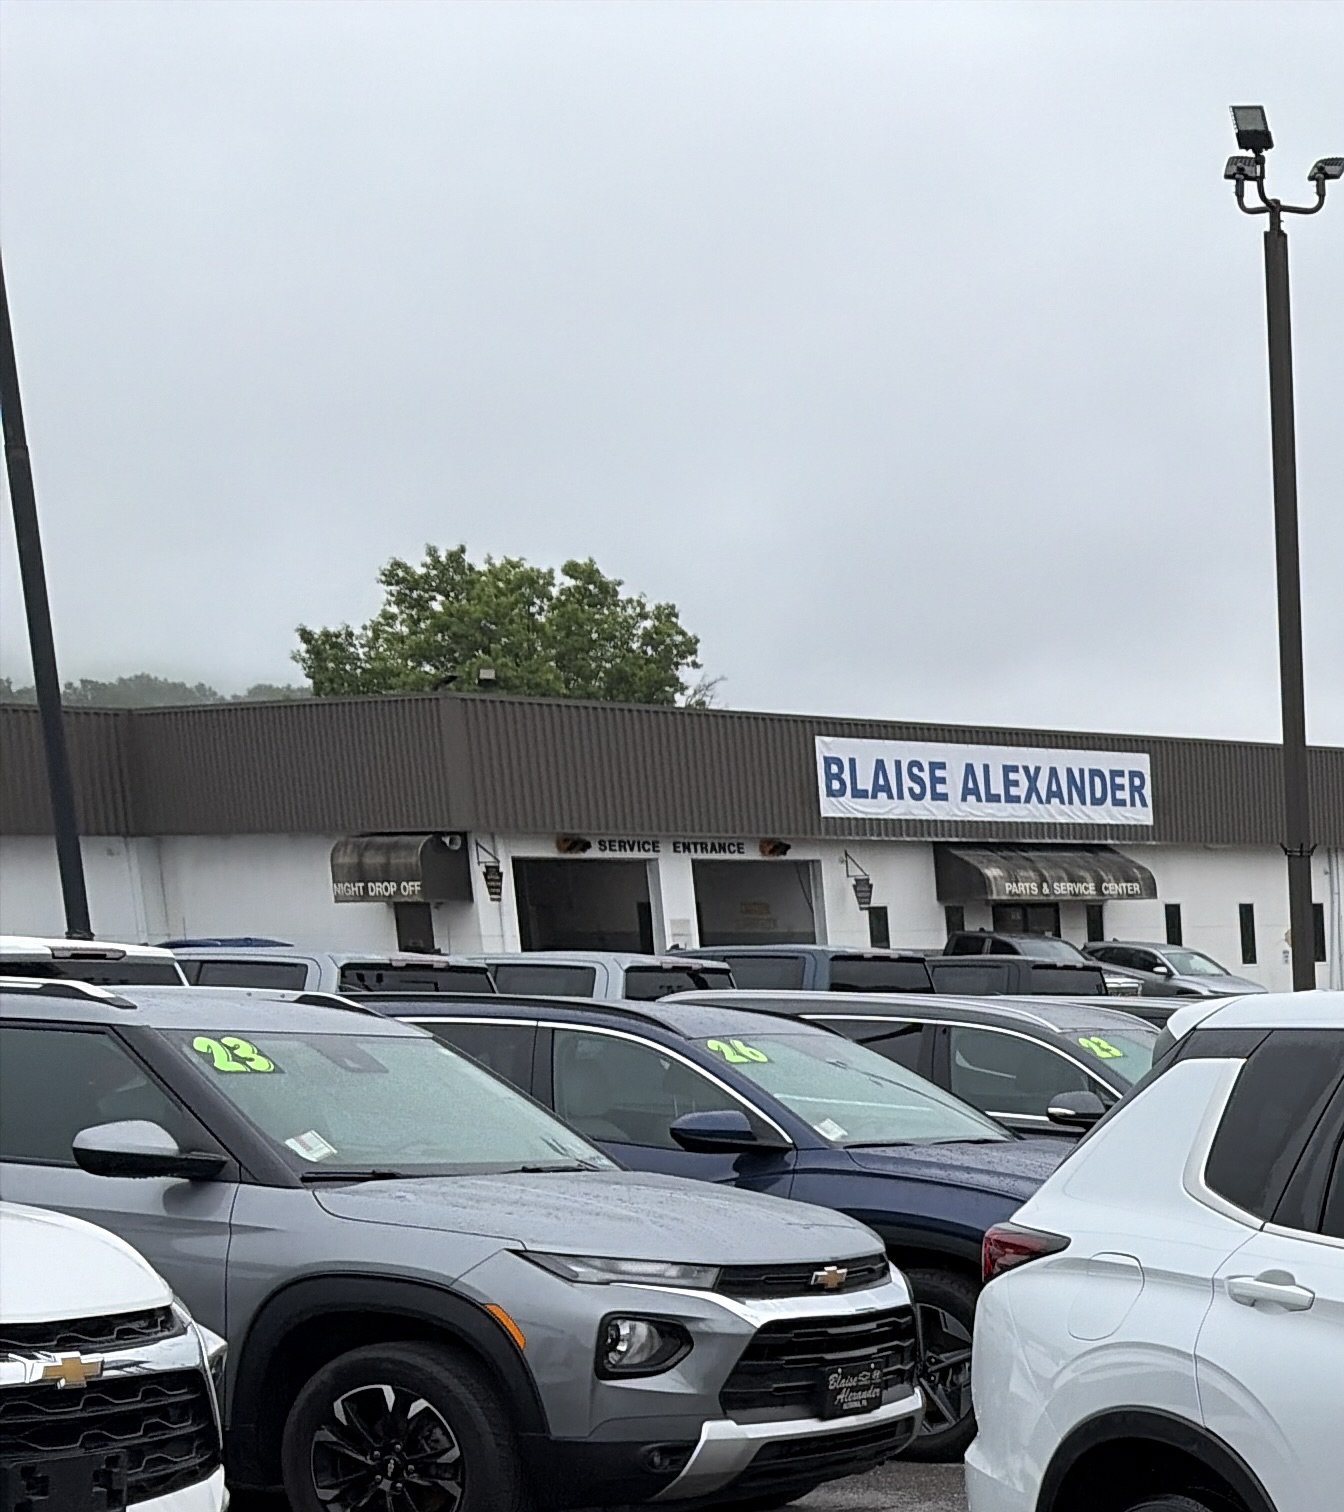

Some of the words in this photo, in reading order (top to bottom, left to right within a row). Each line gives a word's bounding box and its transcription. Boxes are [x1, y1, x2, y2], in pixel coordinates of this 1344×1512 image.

[822, 755, 949, 801] BLAISE
[960, 762, 1149, 808] ALEXANDER
[597, 839, 661, 853] SERVICE
[672, 841, 745, 855] ENTRANCE
[333, 881, 365, 897] NIGHT
[368, 882, 397, 897] DROP
[400, 881, 423, 896] OFF
[1005, 882, 1039, 895] PARTS
[1042, 883, 1050, 895] &
[1053, 882, 1097, 896] SERVICE
[1101, 882, 1141, 896] CENTER
[193, 1036, 275, 1073] 23
[707, 1039, 769, 1063] 26
[1079, 1036, 1123, 1058] 23
[828, 1373, 858, 1390] Blaise
[834, 1385, 881, 1405] Alexander
